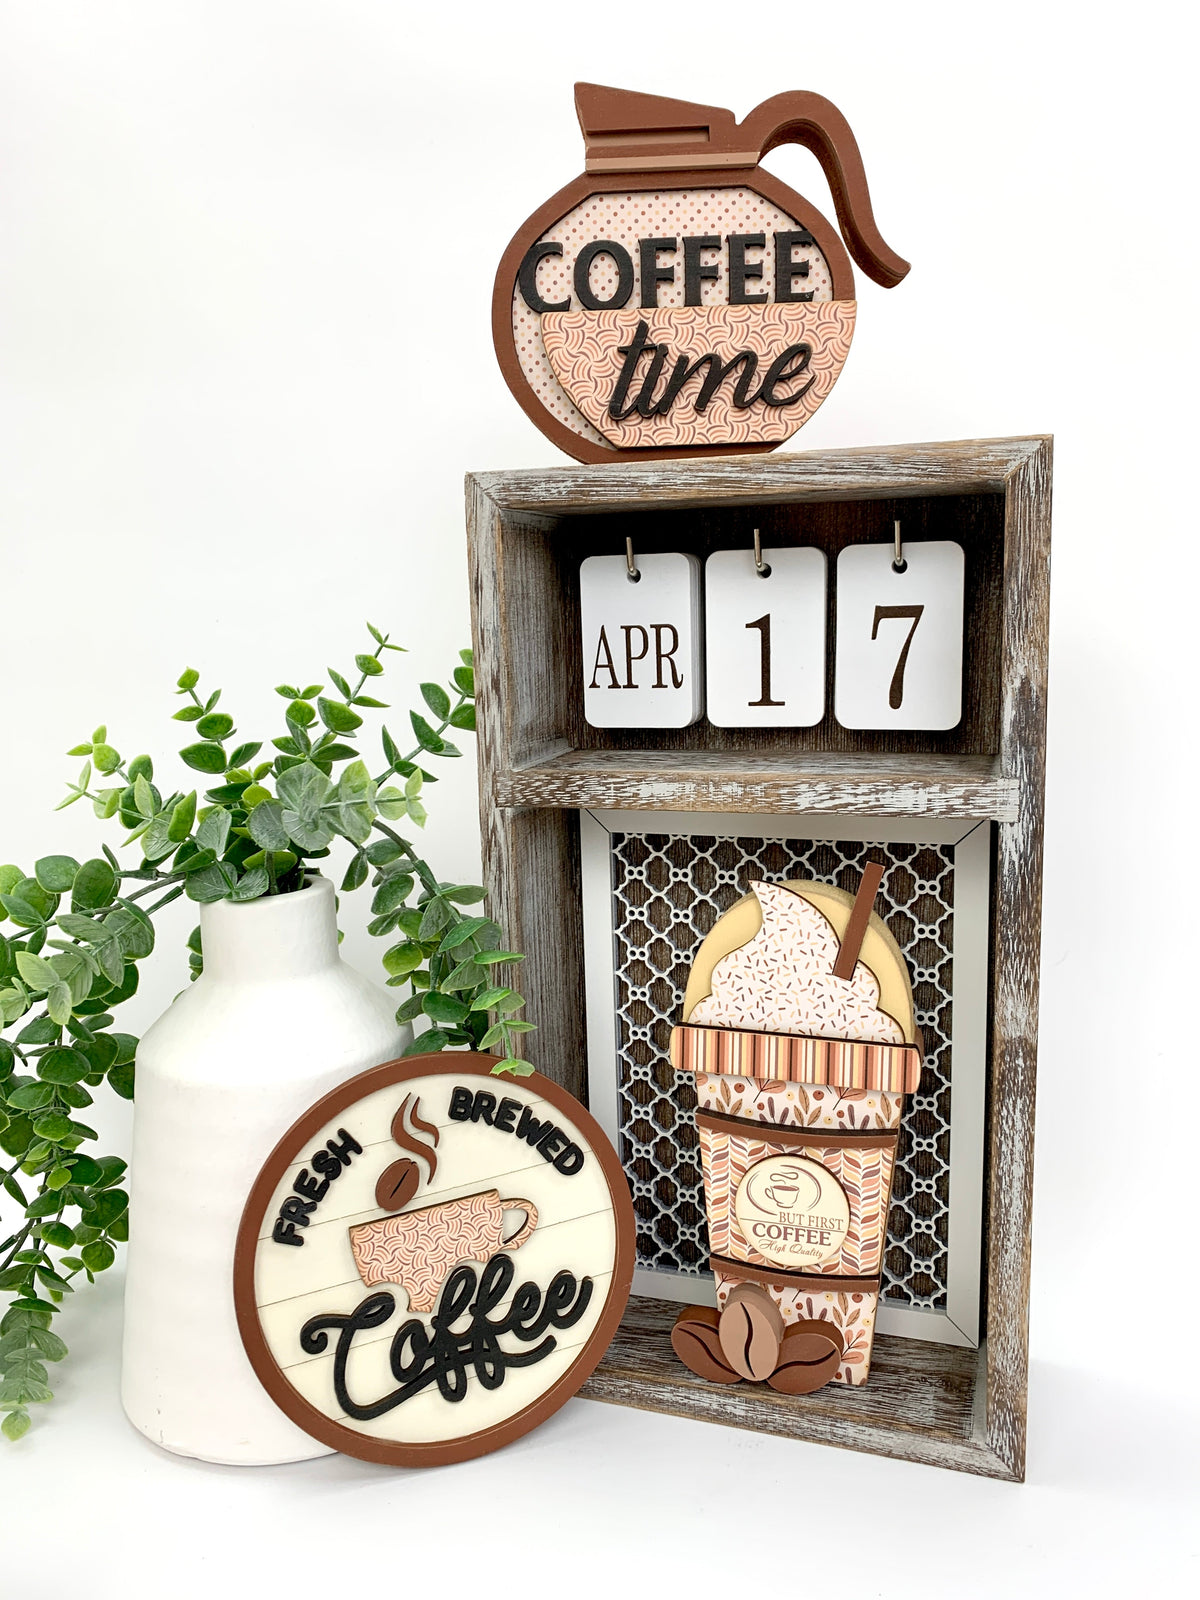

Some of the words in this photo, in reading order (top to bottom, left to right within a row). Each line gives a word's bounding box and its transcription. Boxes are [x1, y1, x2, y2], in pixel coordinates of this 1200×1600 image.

[518, 230, 816, 314] COFFEE
[608, 319, 817, 421] time
[588, 622, 684, 689] APR
[745, 613, 786, 706] 1
[871, 604, 925, 710] 7
[272, 1128, 363, 1246] FRESH
[447, 1086, 585, 1176] BREWED
[752, 1222, 831, 1246] COFFEE
[758, 1238, 785, 1253] High
[789, 1243, 823, 1259] Quality
[779, 1211, 805, 1226] BUT
[808, 1215, 844, 1230] FIRST
[300, 1253, 594, 1421] Coffee
